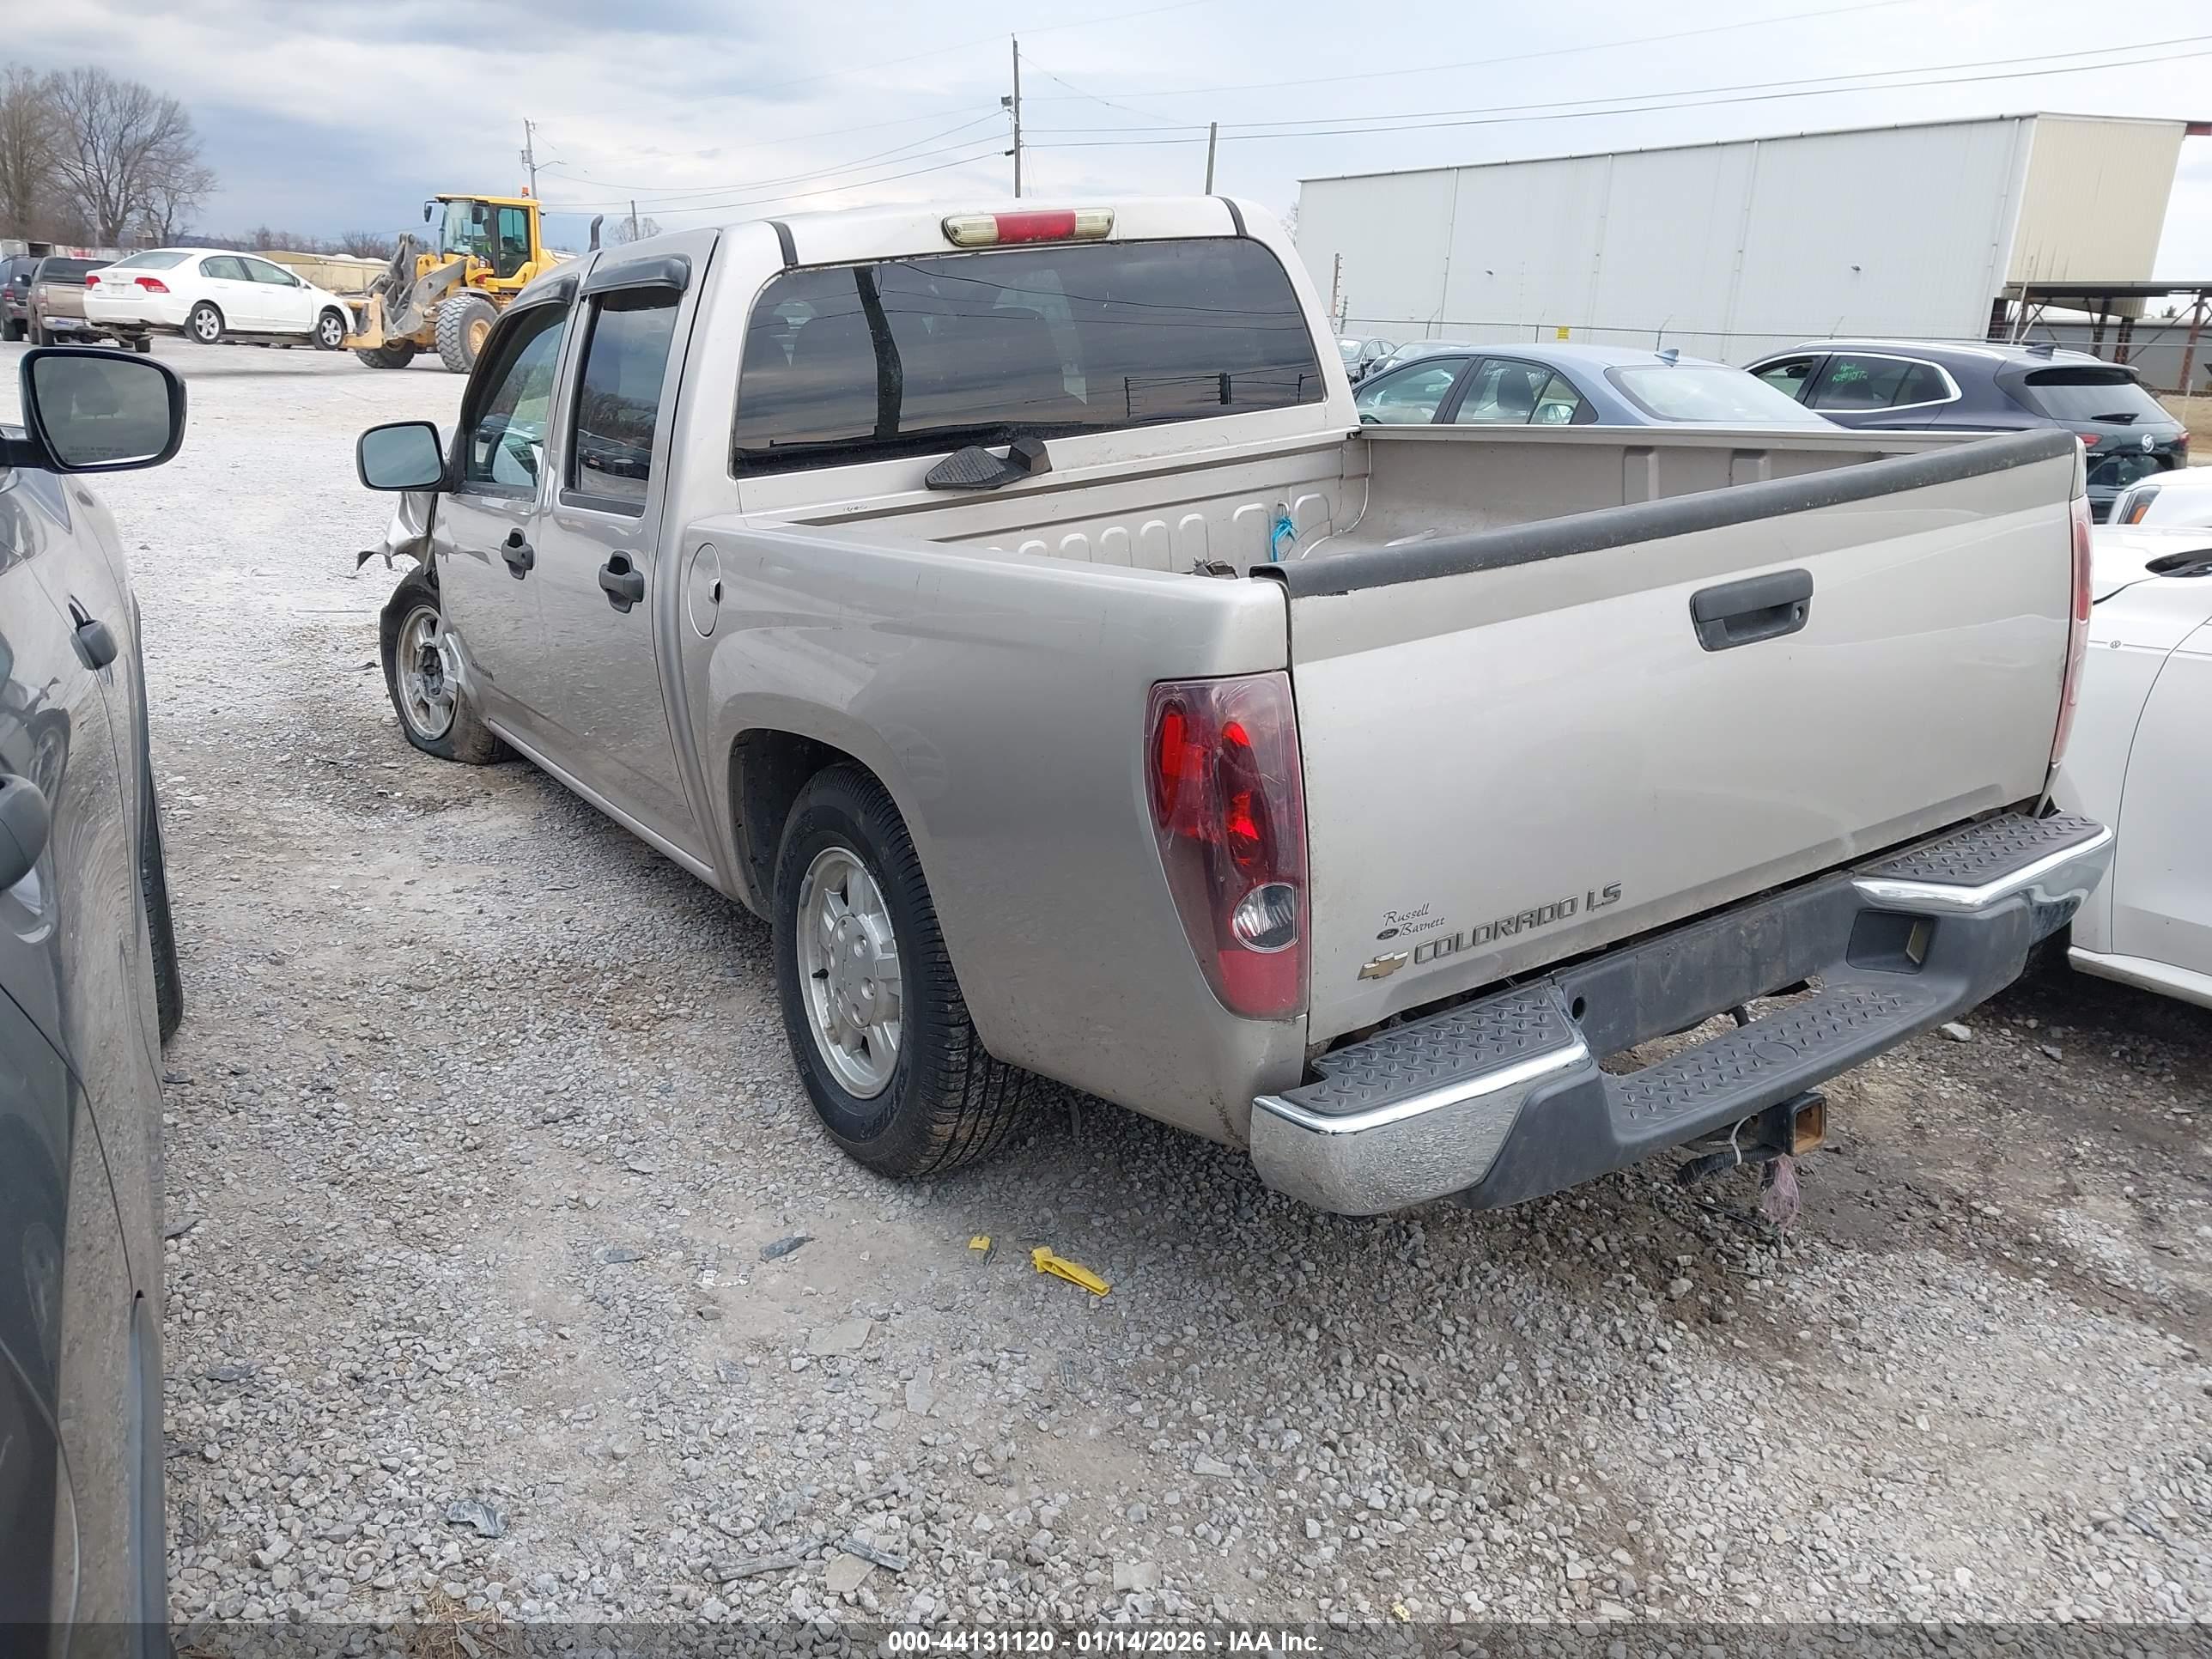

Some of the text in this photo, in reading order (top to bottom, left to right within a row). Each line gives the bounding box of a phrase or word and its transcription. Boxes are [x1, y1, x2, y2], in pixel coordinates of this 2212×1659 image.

[1383, 902, 1430, 927] Russell
[1399, 917, 1445, 937] Barnett
[1414, 881, 1622, 965] COLORADO LS
